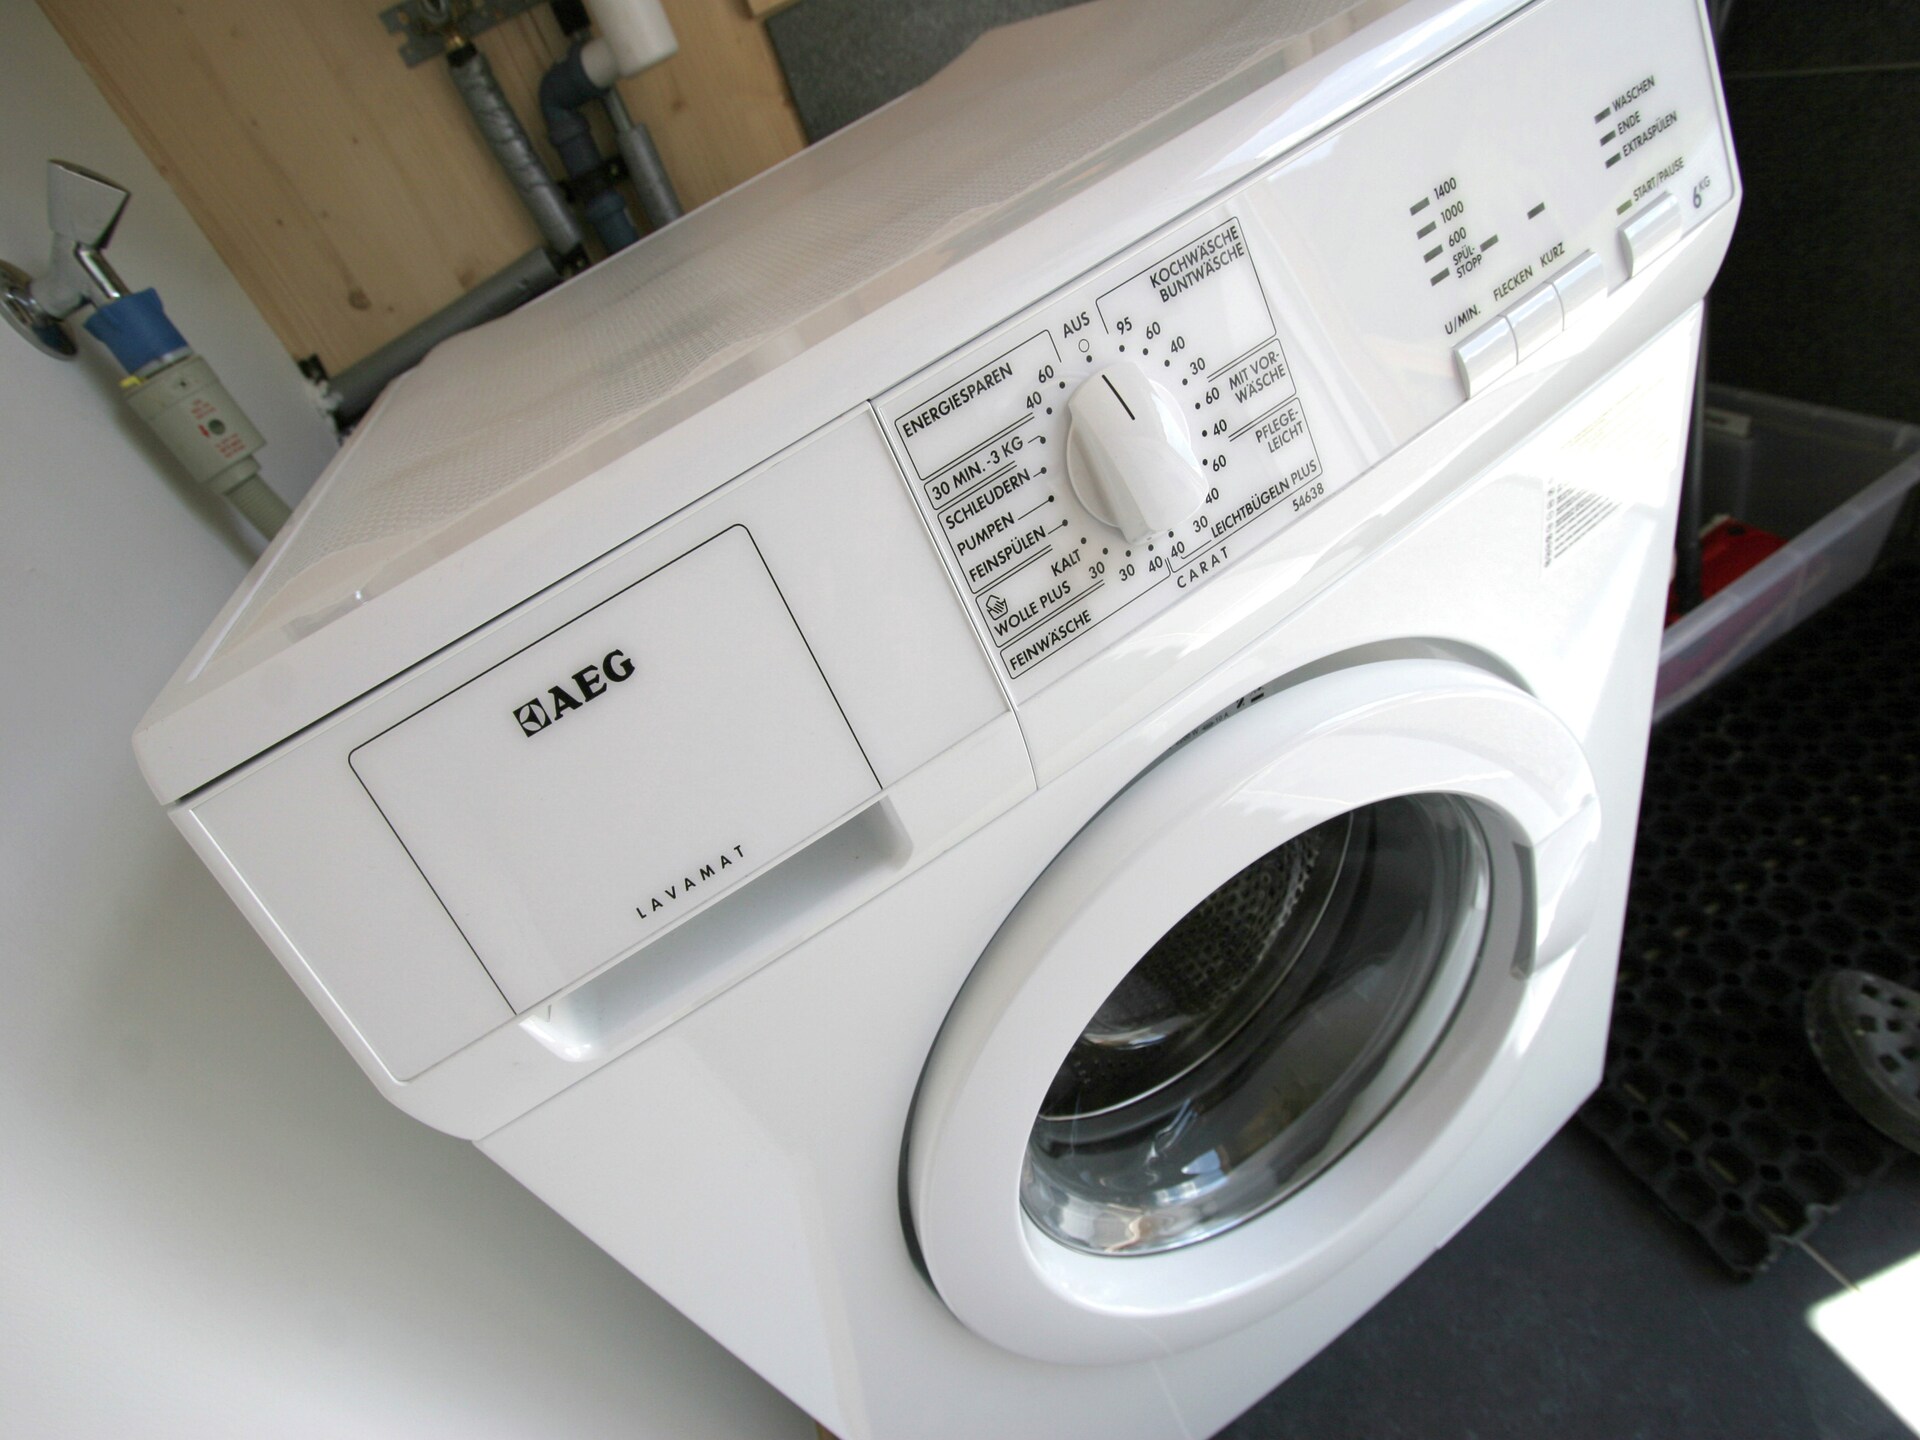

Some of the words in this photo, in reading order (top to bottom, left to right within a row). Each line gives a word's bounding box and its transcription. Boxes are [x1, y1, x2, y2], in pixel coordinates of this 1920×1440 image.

[1611, 75, 1656, 112] WASCHEN
[1617, 110, 1642, 136] ENDE
[1622, 110, 1678, 158] EXTRASPÜLEN
[1433, 177, 1458, 201] 1400
[1632, 156, 1686, 203] START/PAUSE
[1440, 200, 1465, 224] 1000
[1448, 226, 1467, 248] 600
[1150, 225, 1239, 288] KOCHWÄSCHE
[1452, 245, 1476, 267] SPÜL-
[1456, 254, 1483, 279] STOPP
[1539, 242, 1566, 268] KURZ
[1159, 242, 1245, 303] BUNTWÄSCHE
[1493, 265, 1534, 302] FLECKEN
[1062, 311, 1090, 338] AUS
[1116, 316, 1133, 335] 95
[1145, 321, 1161, 340] 60
[1444, 304, 1481, 335] U/MIN.
[1170, 336, 1185, 354] 40
[1037, 365, 1054, 384] 60
[1189, 357, 1206, 375] 30
[1228, 369, 1249, 391] MIT
[1249, 351, 1280, 377] VOR-
[1205, 387, 1220, 405] 60
[1234, 364, 1286, 404] WÄSCHE
[902, 362, 1013, 438] ENERGIESPAREN
[1025, 391, 1042, 409] 40
[1212, 419, 1228, 437] 40
[1255, 408, 1299, 444] PFLEGE-
[1267, 421, 1305, 454] LEICHT
[931, 481, 950, 501] 30
[953, 461, 986, 489] MIN.
[1001, 436, 1023, 458] KG
[1212, 454, 1227, 472] 60
[945, 468, 1031, 530] SCHLEUDERN
[1210, 478, 1290, 539] LEICHTBÜGELN
[1290, 459, 1317, 485] PLUS
[1292, 482, 1325, 513] 54638
[956, 512, 1015, 556] PUMPEN
[1192, 515, 1208, 534] 30
[968, 525, 1046, 582] FEINSPÜLEN
[1050, 549, 1082, 577] KALT
[1170, 541, 1185, 559] 40
[1088, 561, 1105, 580] 30
[1119, 563, 1135, 582] 30
[1148, 556, 1163, 574] 40
[993, 601, 1039, 637] WOLLE
[1039, 580, 1072, 608] PLUS
[1009, 609, 1092, 671] FEINWÄSCHE
[548, 649, 636, 721] AEG
[635, 844, 745, 919] LAVAMAT
